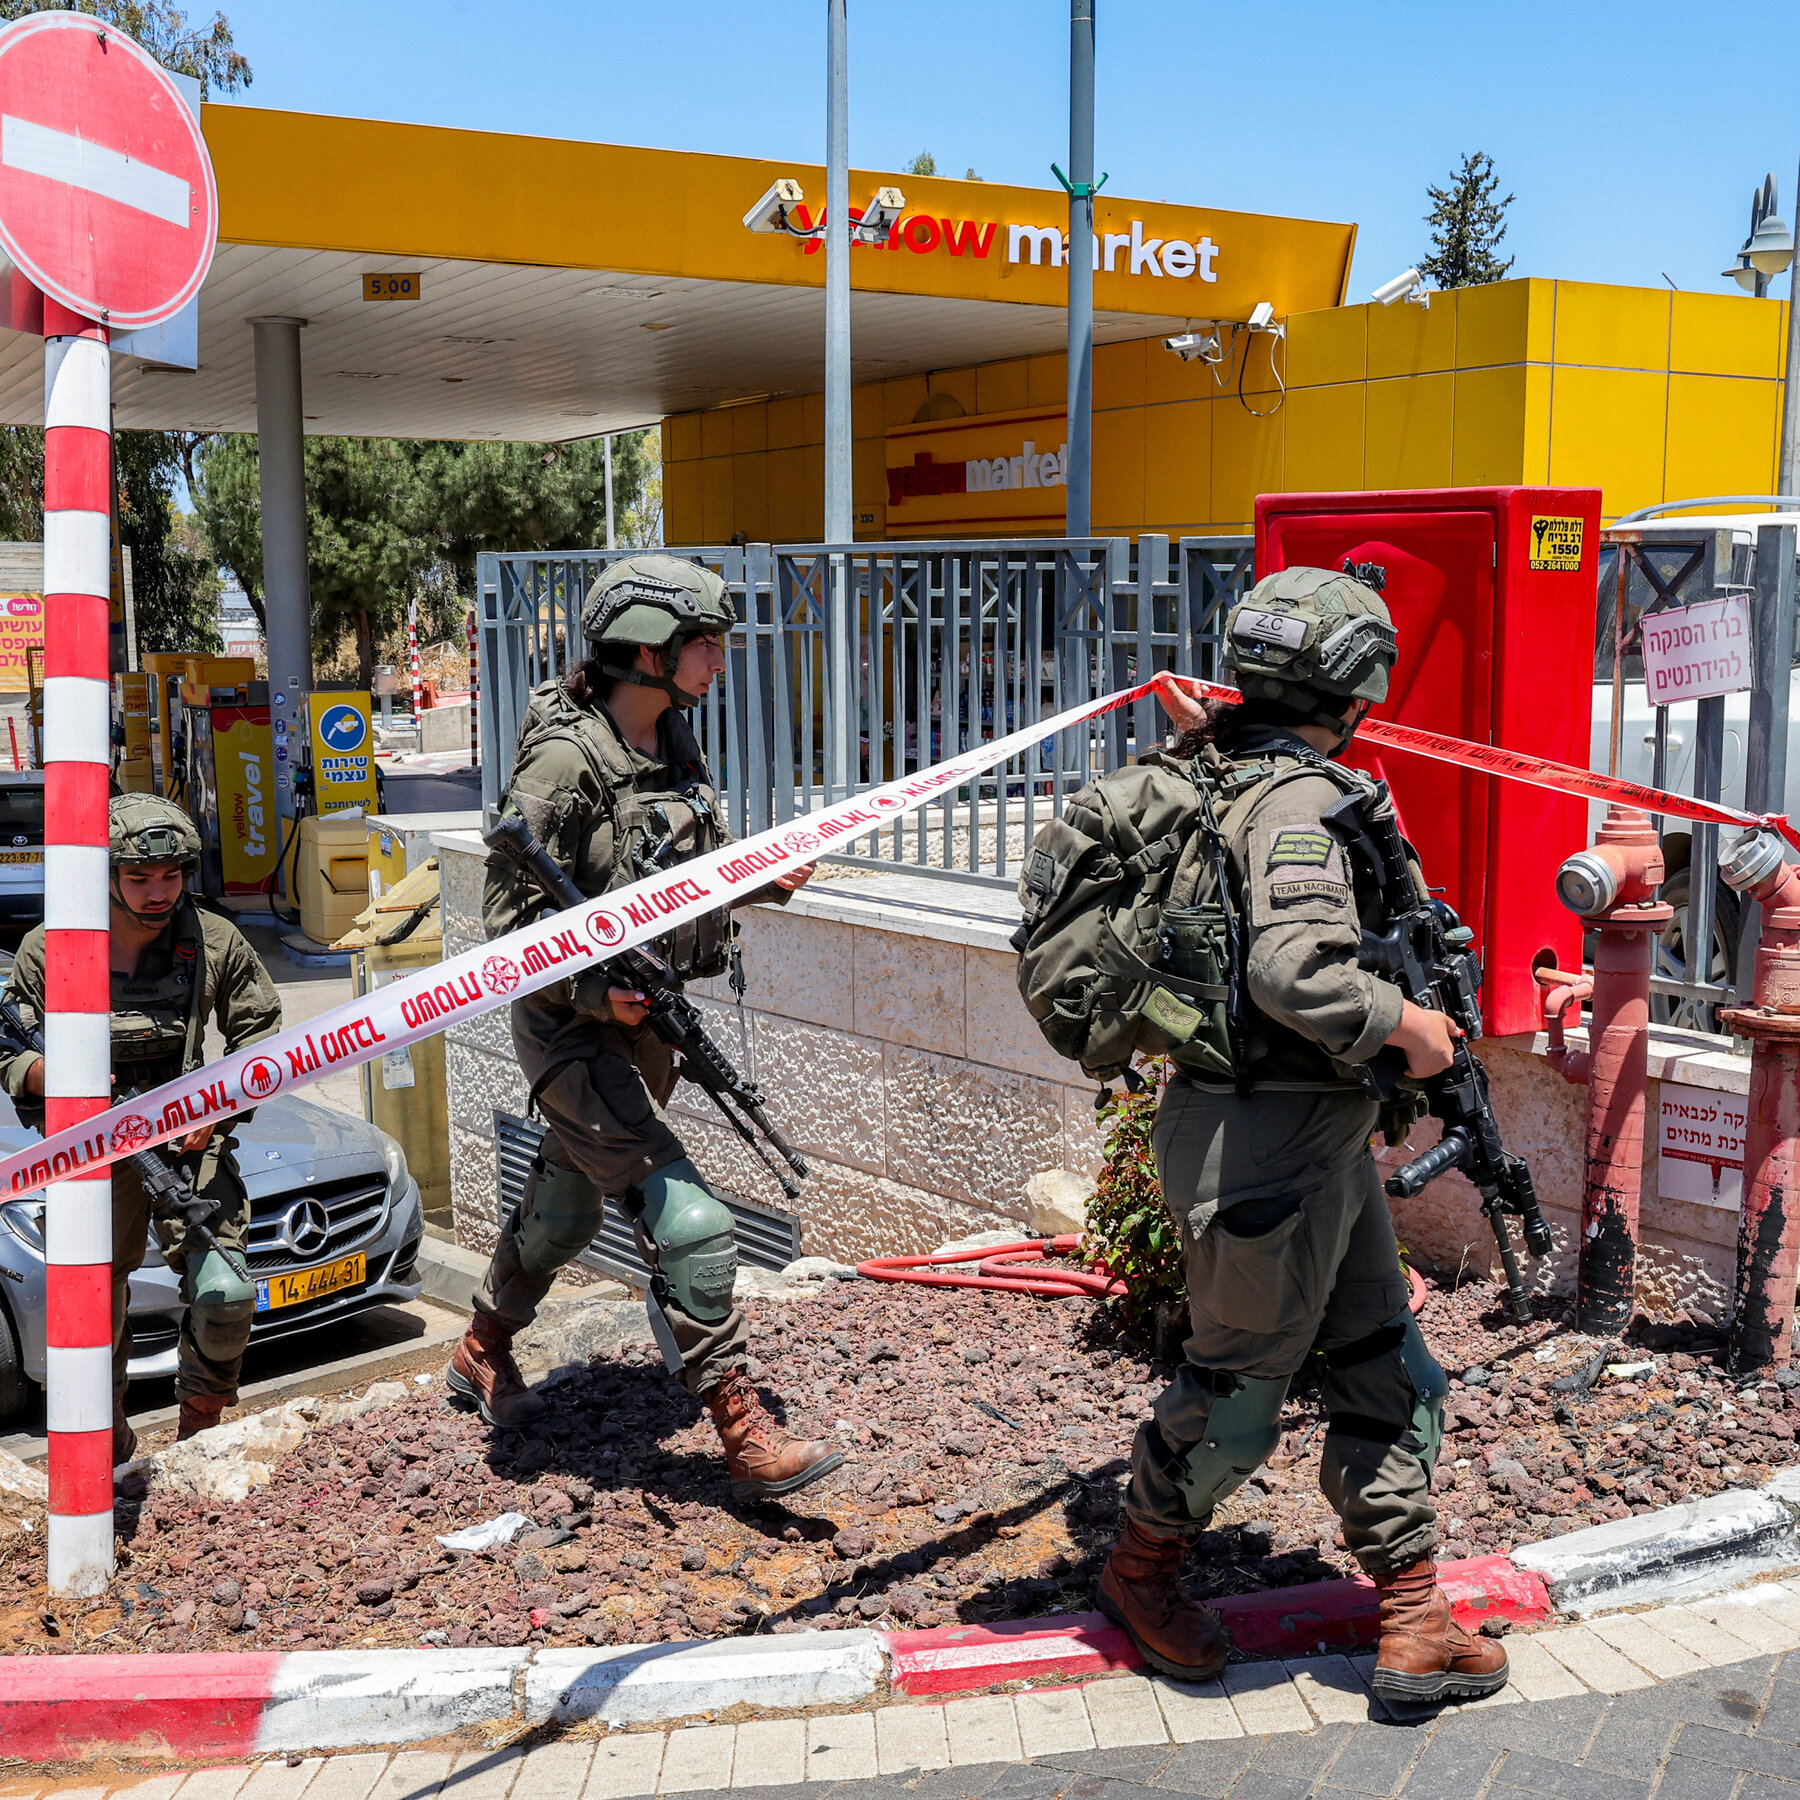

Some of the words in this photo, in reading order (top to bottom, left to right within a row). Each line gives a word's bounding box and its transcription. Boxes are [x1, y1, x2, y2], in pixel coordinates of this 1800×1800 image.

[795, 204, 997, 259] ylow
[371, 279, 412, 294] 5.00
[1548, 532, 1568, 543] בריח
[1570, 533, 1581, 543] רב
[1530, 560, 1579, 571] 052-2641000
[12, 602, 37, 611] חדש!
[1711, 616, 1742, 641] ברז
[0, 637, 45, 650] ומפס
[1650, 623, 1706, 656] הסנקה
[1655, 650, 1742, 690] להידרנטים
[321, 756, 369, 770] שירות
[325, 769, 367, 783] עצמי
[238, 751, 266, 857] travel
[232, 793, 247, 839] yellow
[1276, 884, 1301, 895] TEAM
[1303, 882, 1345, 896] NACHMAN
[157, 1079, 238, 1135] ישראל
[285, 1034, 322, 1079] אין
[321, 1016, 386, 1062] מעבר
[400, 971, 483, 1029] משטרת
[519, 929, 593, 977] ישראל
[621, 893, 654, 928] אין
[650, 878, 711, 915] מעבר
[717, 842, 790, 884] משטרת
[817, 808, 882, 839] ישראל
[1661, 1101, 1717, 1123] לכבאית
[1722, 1111, 1748, 1131] קה
[1666, 1126, 1711, 1147] מתזים
